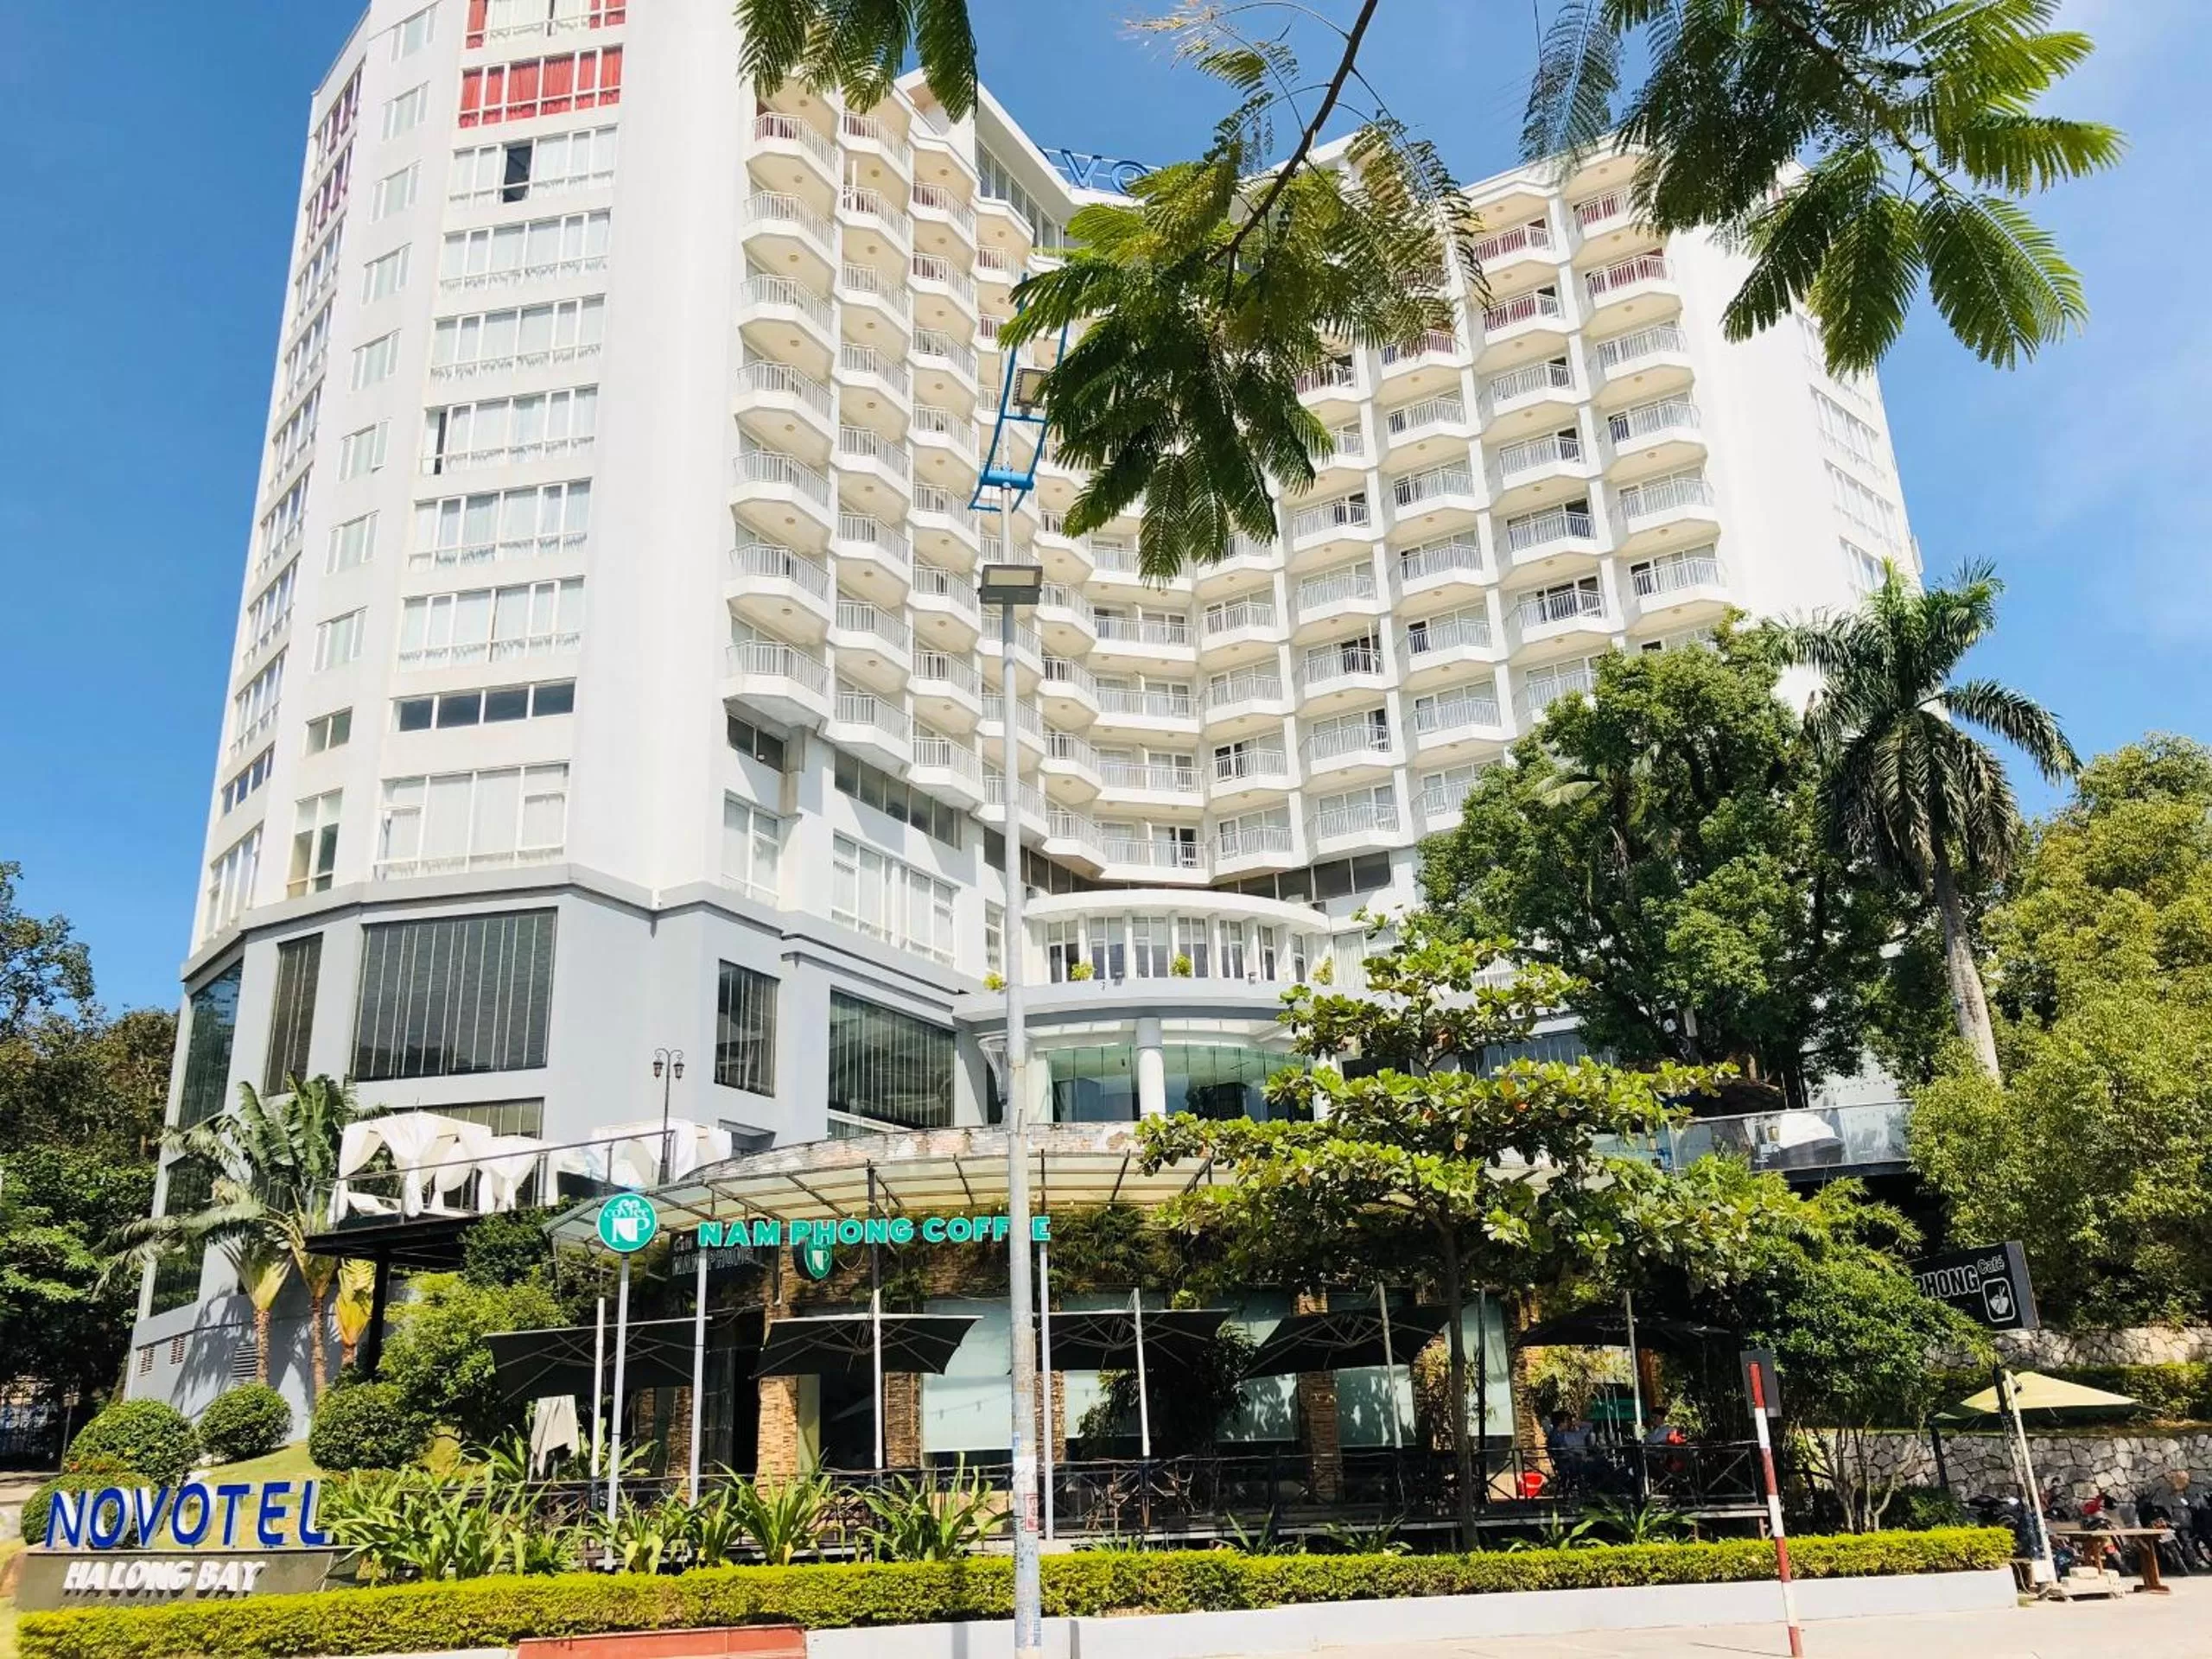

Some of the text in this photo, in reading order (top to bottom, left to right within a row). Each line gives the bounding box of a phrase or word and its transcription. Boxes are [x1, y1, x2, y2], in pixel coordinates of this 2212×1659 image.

[698, 1219, 781, 1247] NAM
[789, 1217, 914, 1245] PHONG
[923, 1216, 1051, 1243] COFFE
[1977, 1255, 2005, 1274] Café
[45, 1479, 330, 1549] NOVOTEL
[63, 1560, 266, 1592] HALONG BAY
